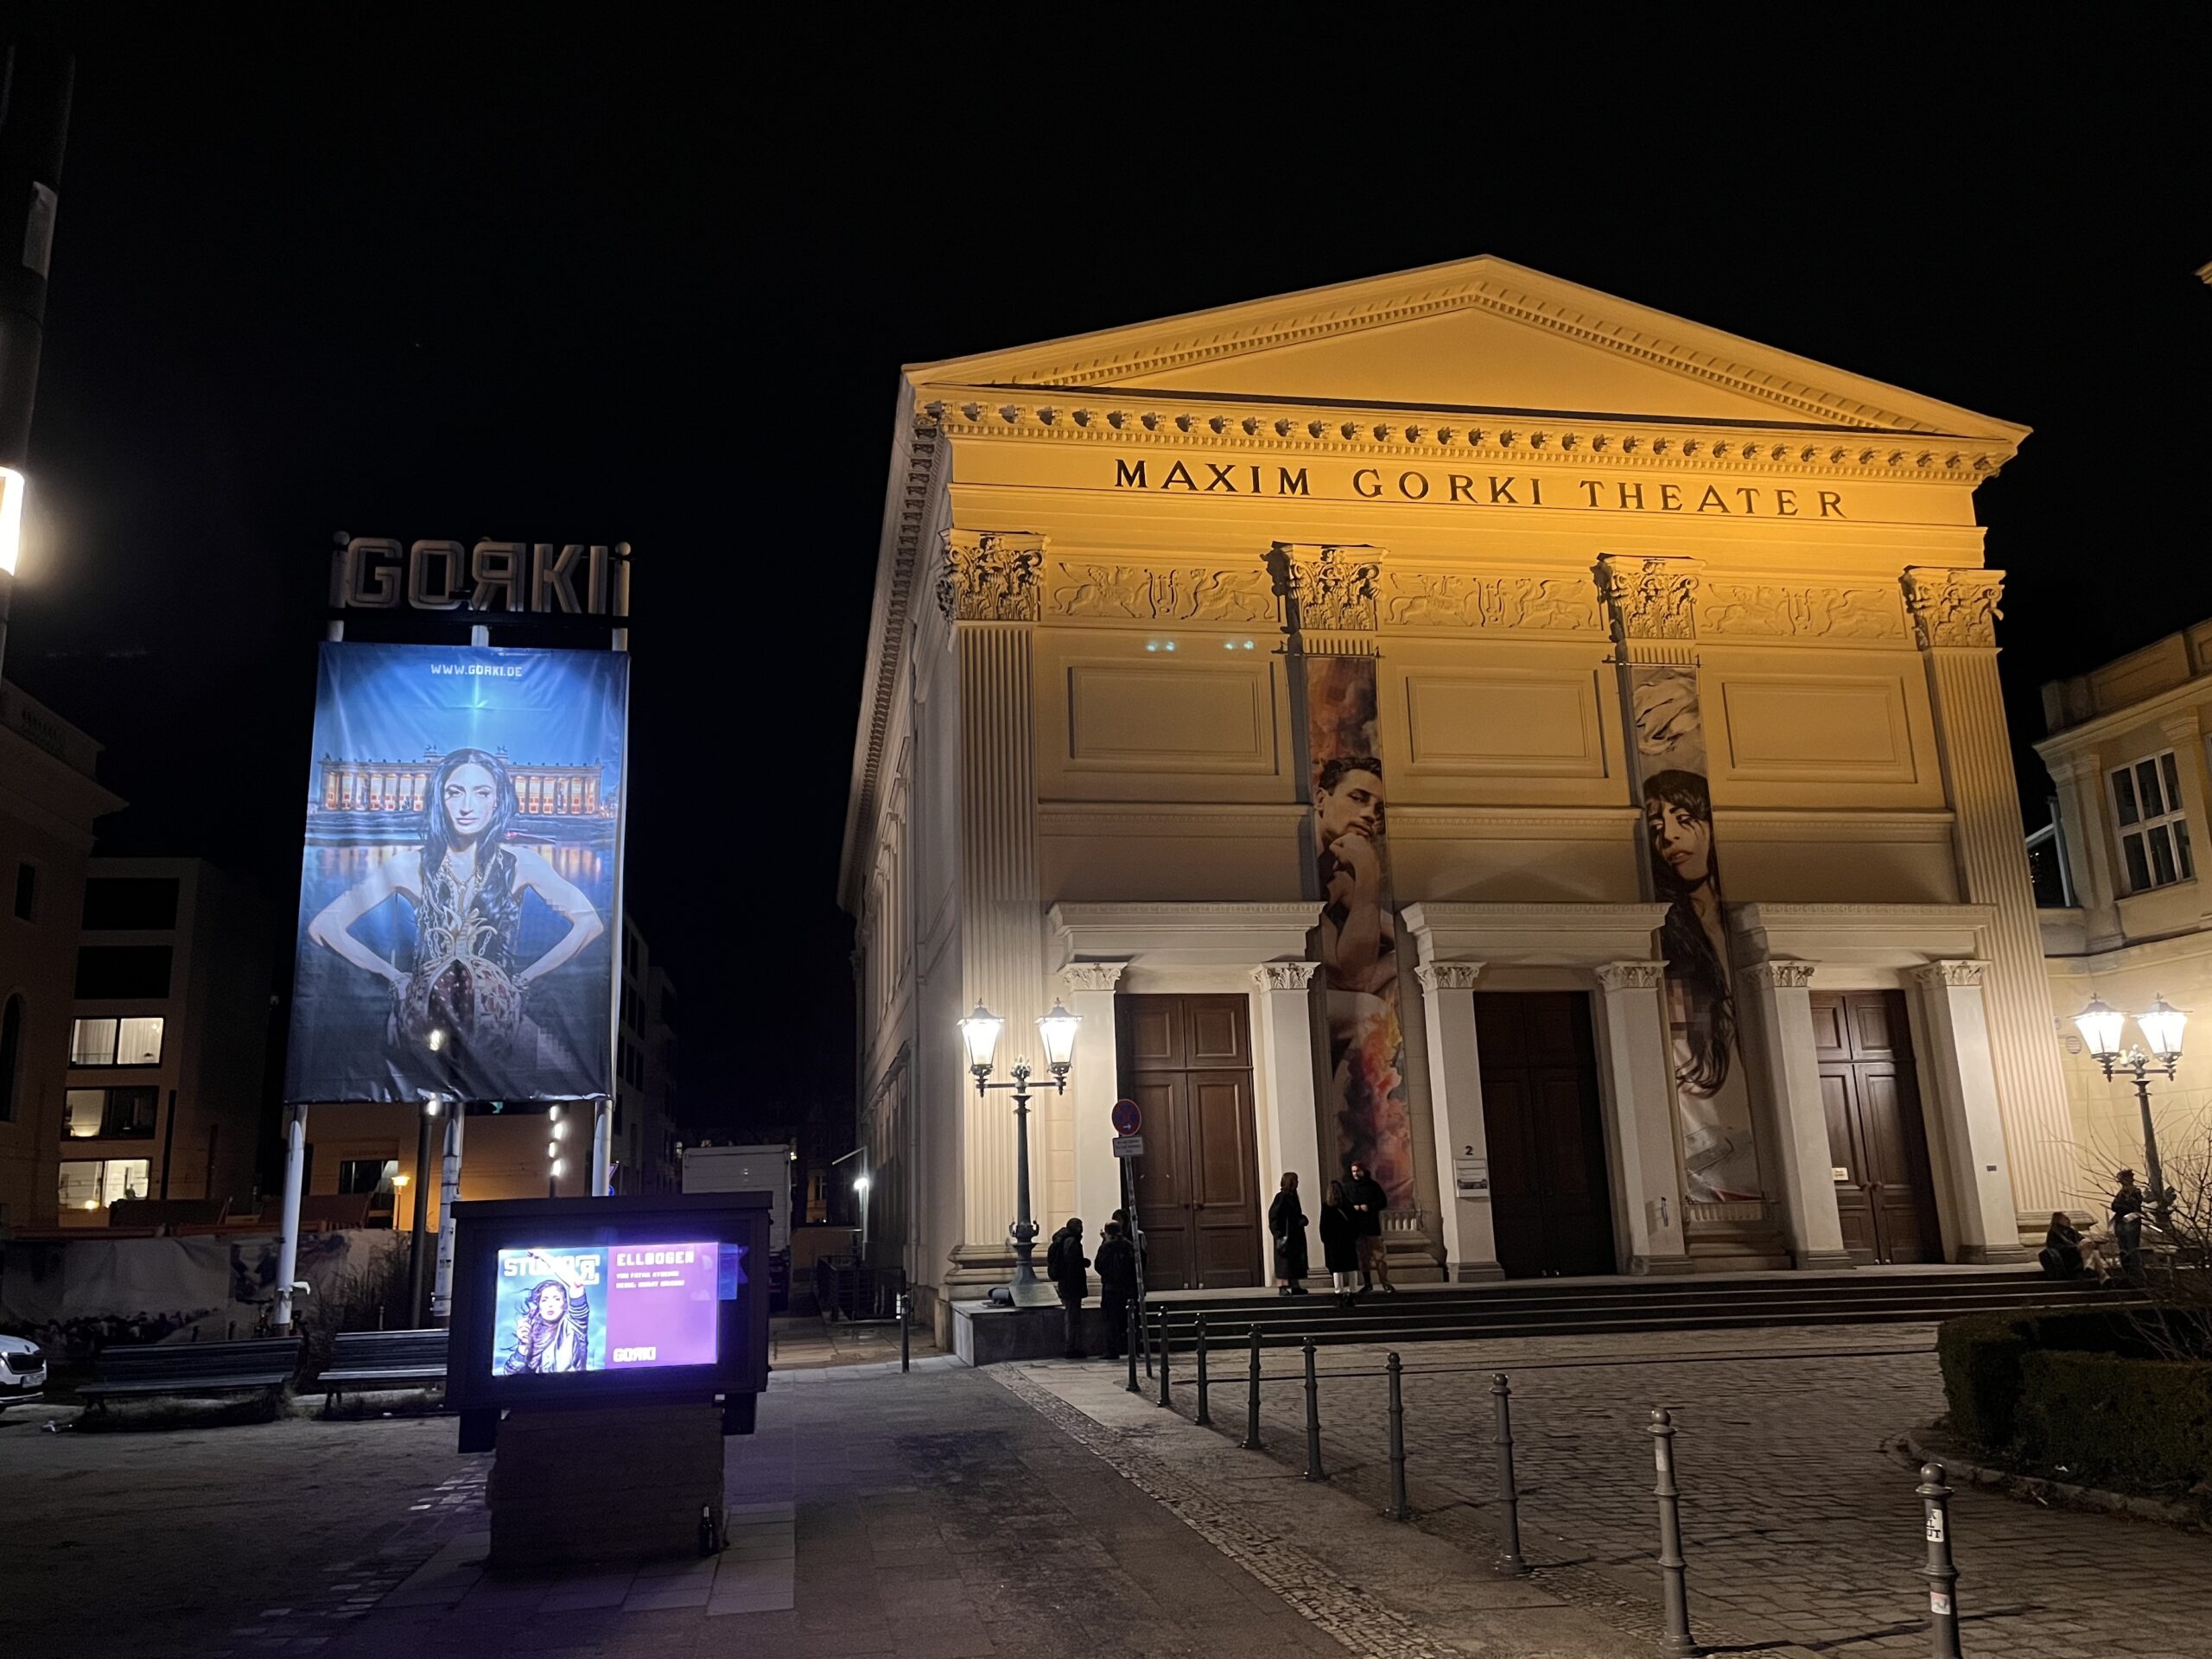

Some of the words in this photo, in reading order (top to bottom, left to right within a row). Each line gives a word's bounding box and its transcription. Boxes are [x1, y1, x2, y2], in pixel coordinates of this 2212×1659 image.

[1115, 458, 1311, 496] MAXIM
[1352, 468, 1543, 505] GORKI
[1580, 480, 1847, 518] THEATER
[430, 664, 523, 677] WWW.GORKI.DE
[1465, 1145, 1473, 1156] 2
[616, 1250, 695, 1267] ELLBOGEN
